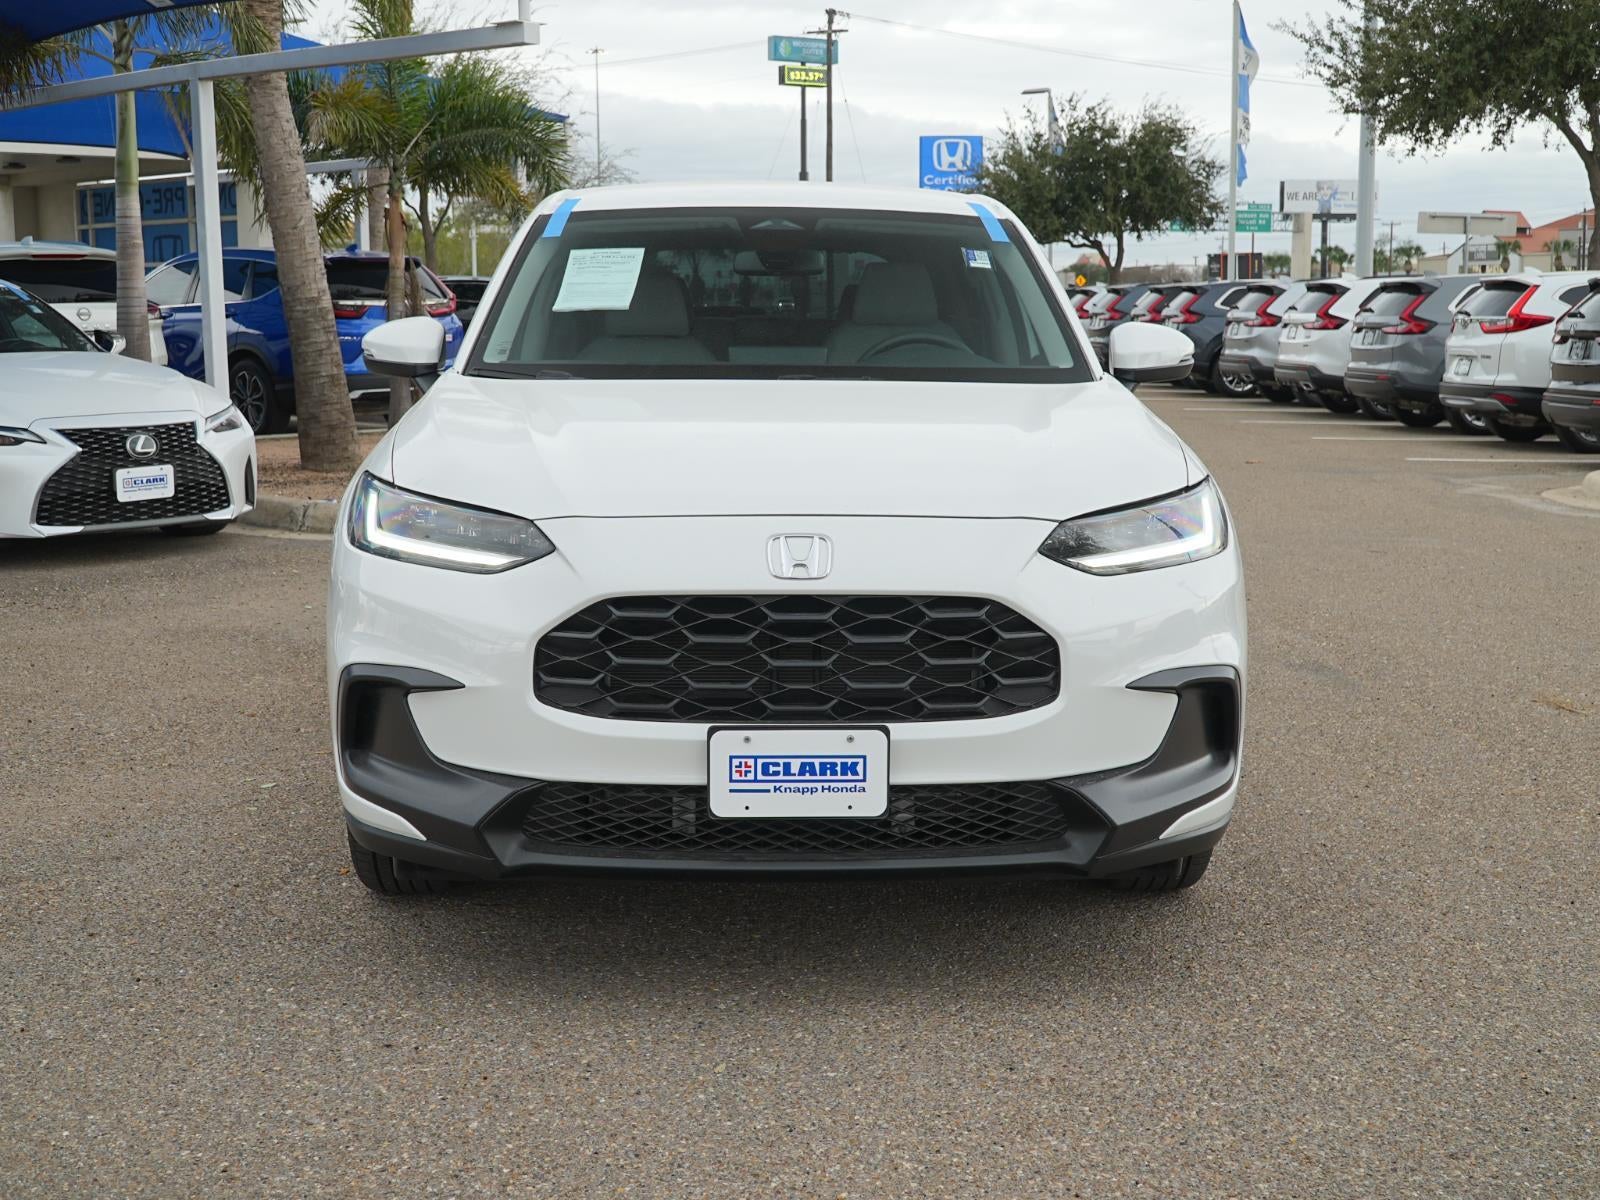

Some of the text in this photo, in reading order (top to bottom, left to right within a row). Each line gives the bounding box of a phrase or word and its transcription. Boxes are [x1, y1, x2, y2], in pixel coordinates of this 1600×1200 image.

[761, 762, 860, 777] CLARK
[773, 785, 867, 796] Knapp Honda
